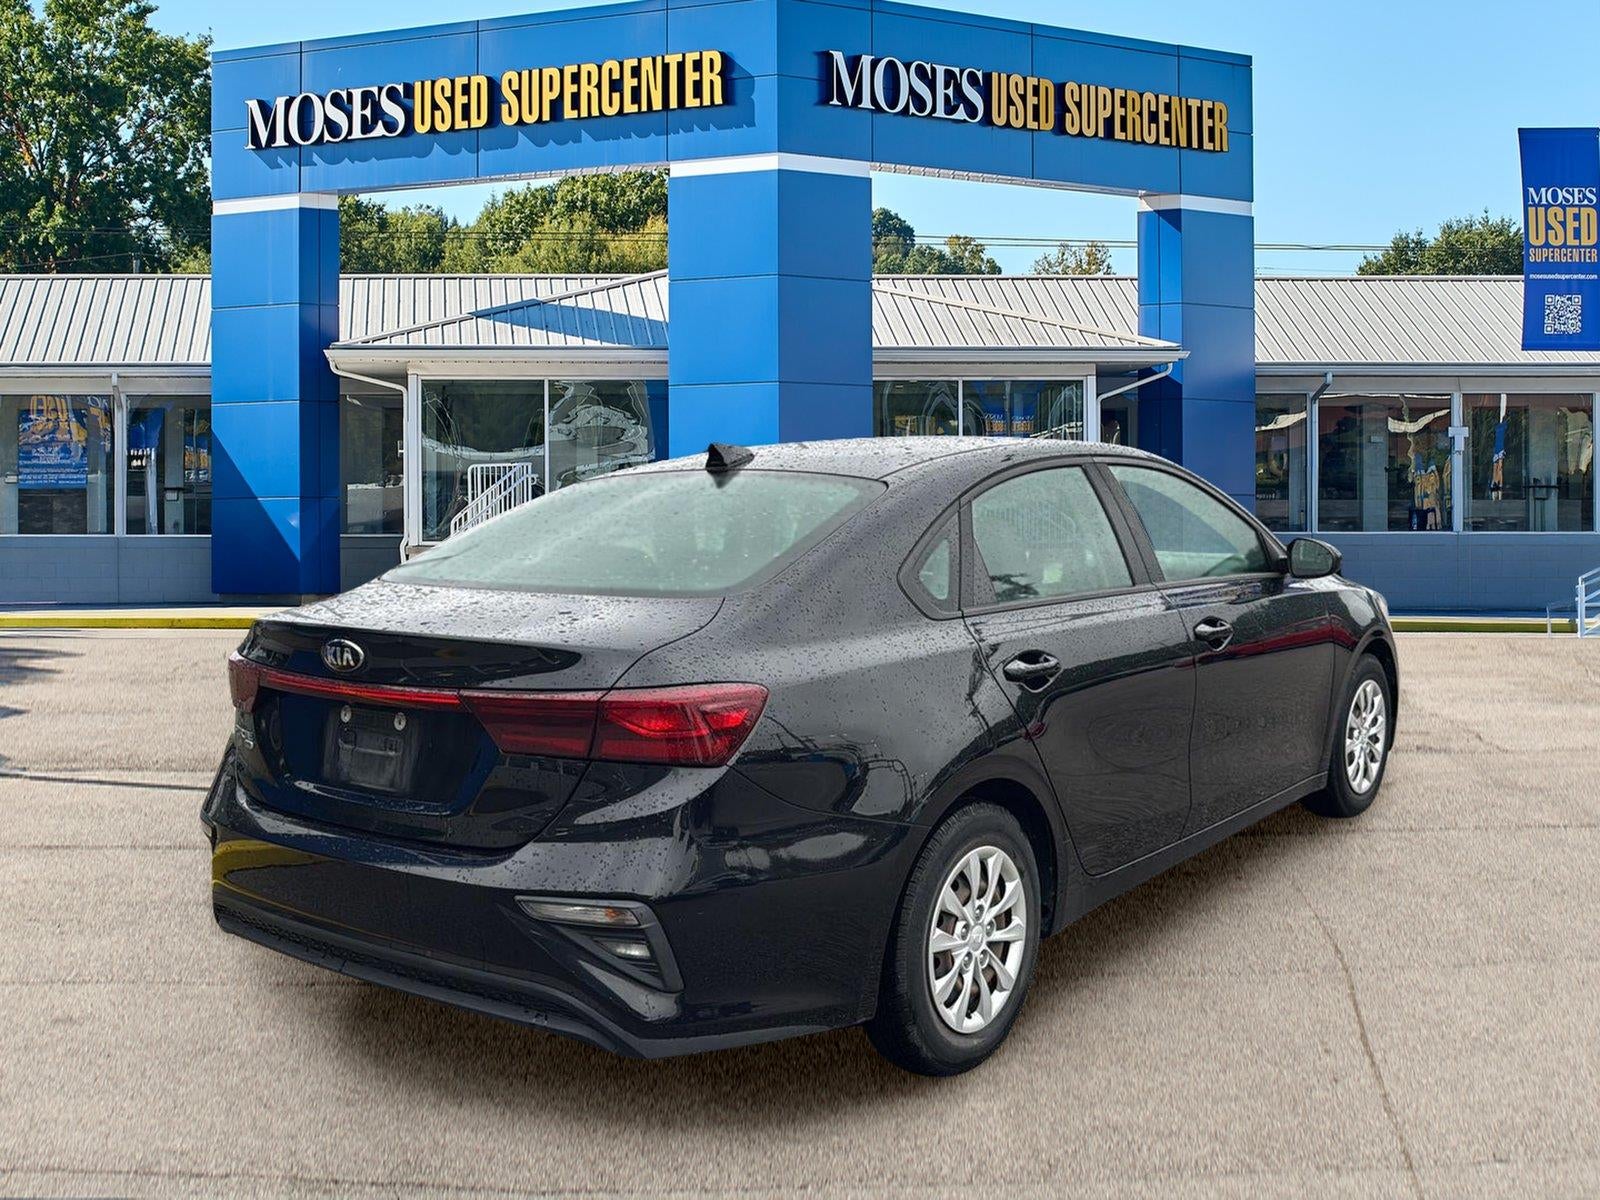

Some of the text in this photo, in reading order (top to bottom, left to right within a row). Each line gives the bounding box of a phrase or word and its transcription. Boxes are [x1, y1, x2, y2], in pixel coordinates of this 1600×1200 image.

[244, 50, 723, 149] MOSES USED SUPERCENTER
[829, 50, 1229, 151] MOSES USED SUPERCENTER
[1527, 187, 1597, 205] MOSES
[1528, 206, 1598, 246] USED
[1529, 248, 1598, 262] SUPERCENTER
[326, 645, 355, 666] KIA
